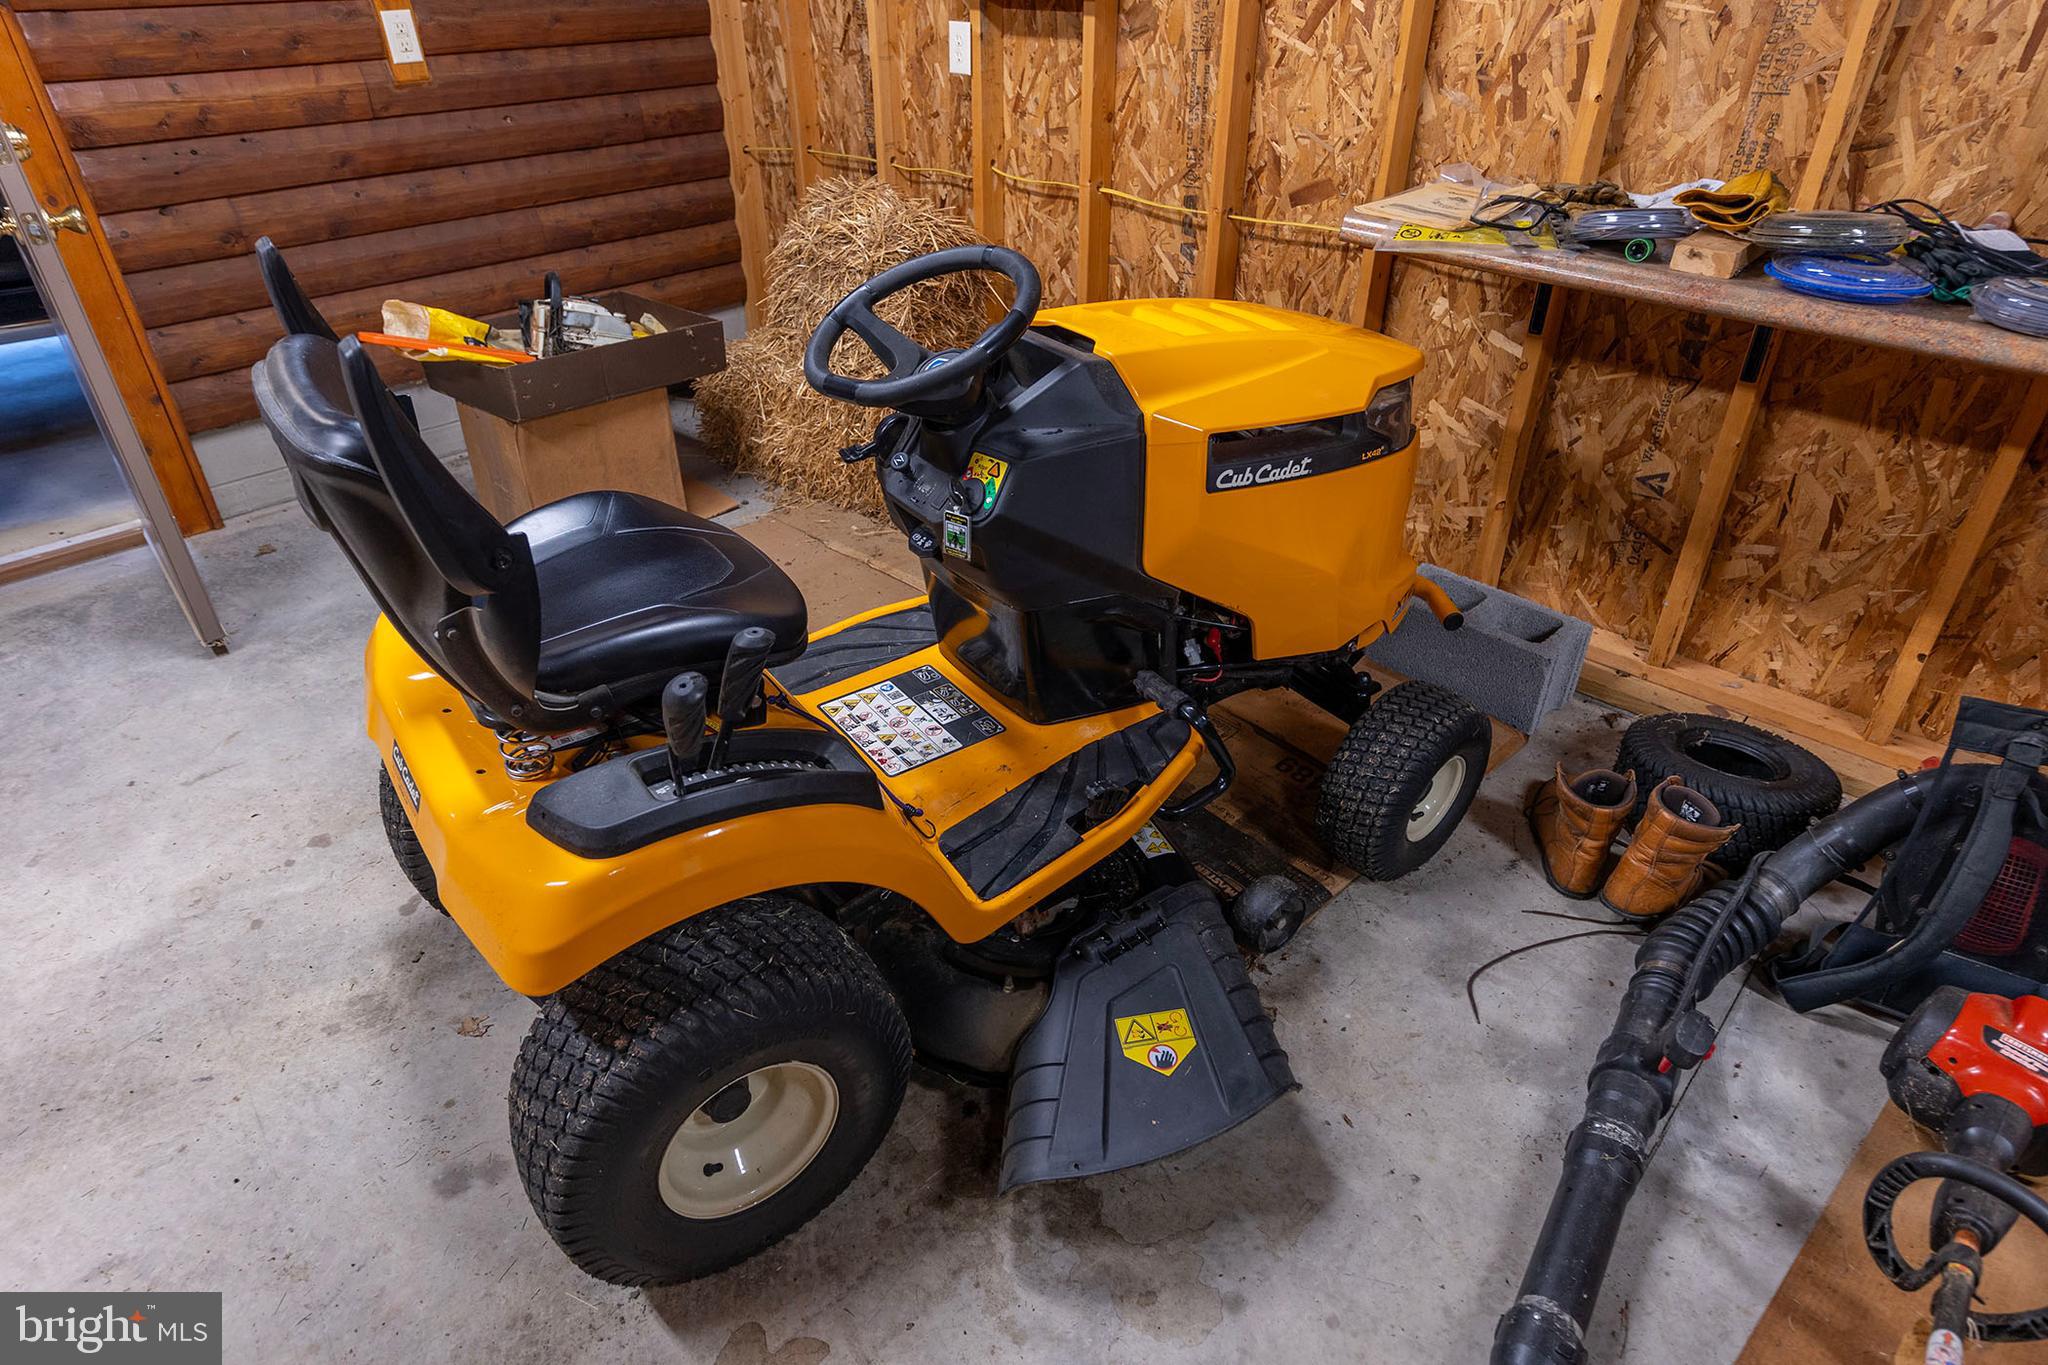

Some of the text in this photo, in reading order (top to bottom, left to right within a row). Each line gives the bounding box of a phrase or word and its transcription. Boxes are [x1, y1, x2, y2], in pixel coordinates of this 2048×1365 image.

[1216, 456, 1313, 489] Cub Cadet
[393, 746, 404, 772] Cub
[402, 766, 420, 805] Cadet
